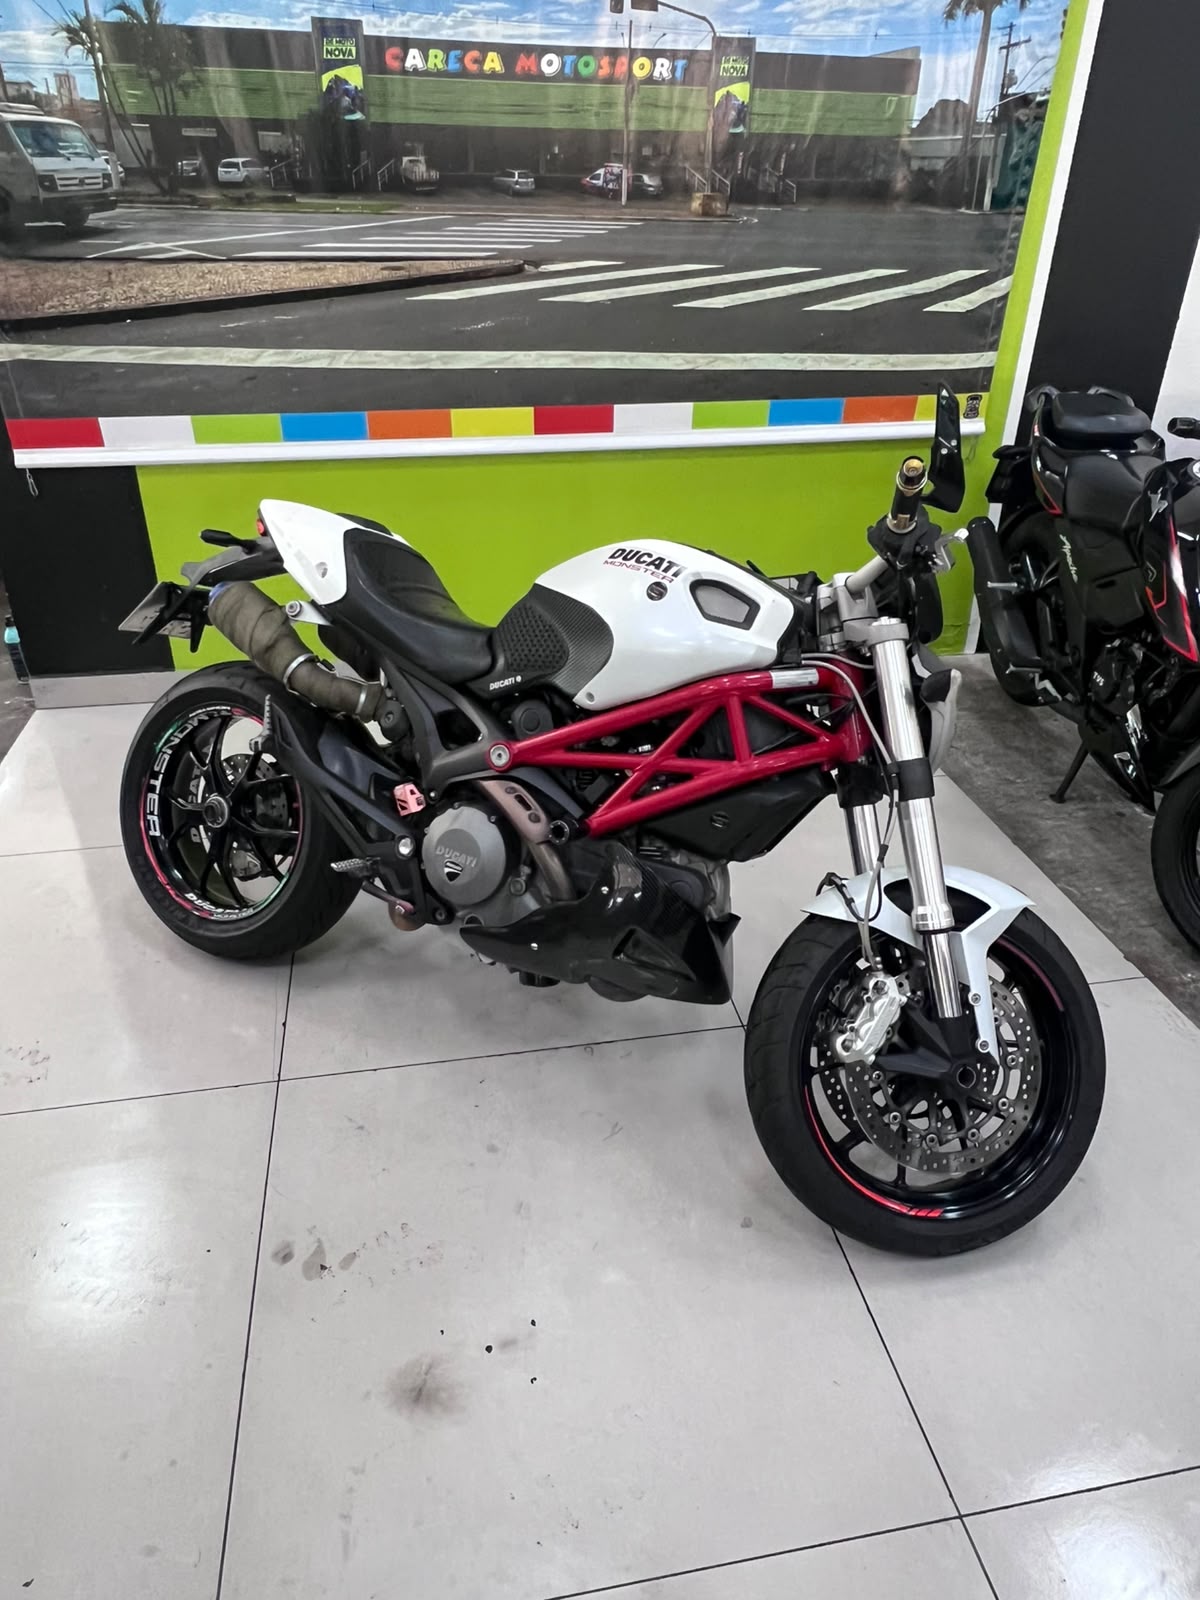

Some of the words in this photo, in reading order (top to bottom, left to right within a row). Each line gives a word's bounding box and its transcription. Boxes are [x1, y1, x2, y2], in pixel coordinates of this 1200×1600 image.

[325, 47, 354, 58] NOVA
[385, 47, 505, 74] CARECA
[515, 52, 688, 81] MOTOSPORT
[722, 65, 746, 76] NOVA
[602, 560, 674, 583] MONSTER
[608, 548, 688, 578] DUCATI
[489, 677, 515, 691] DUCATI
[146, 712, 209, 837] MONSTER
[435, 846, 477, 867] DUCATI
